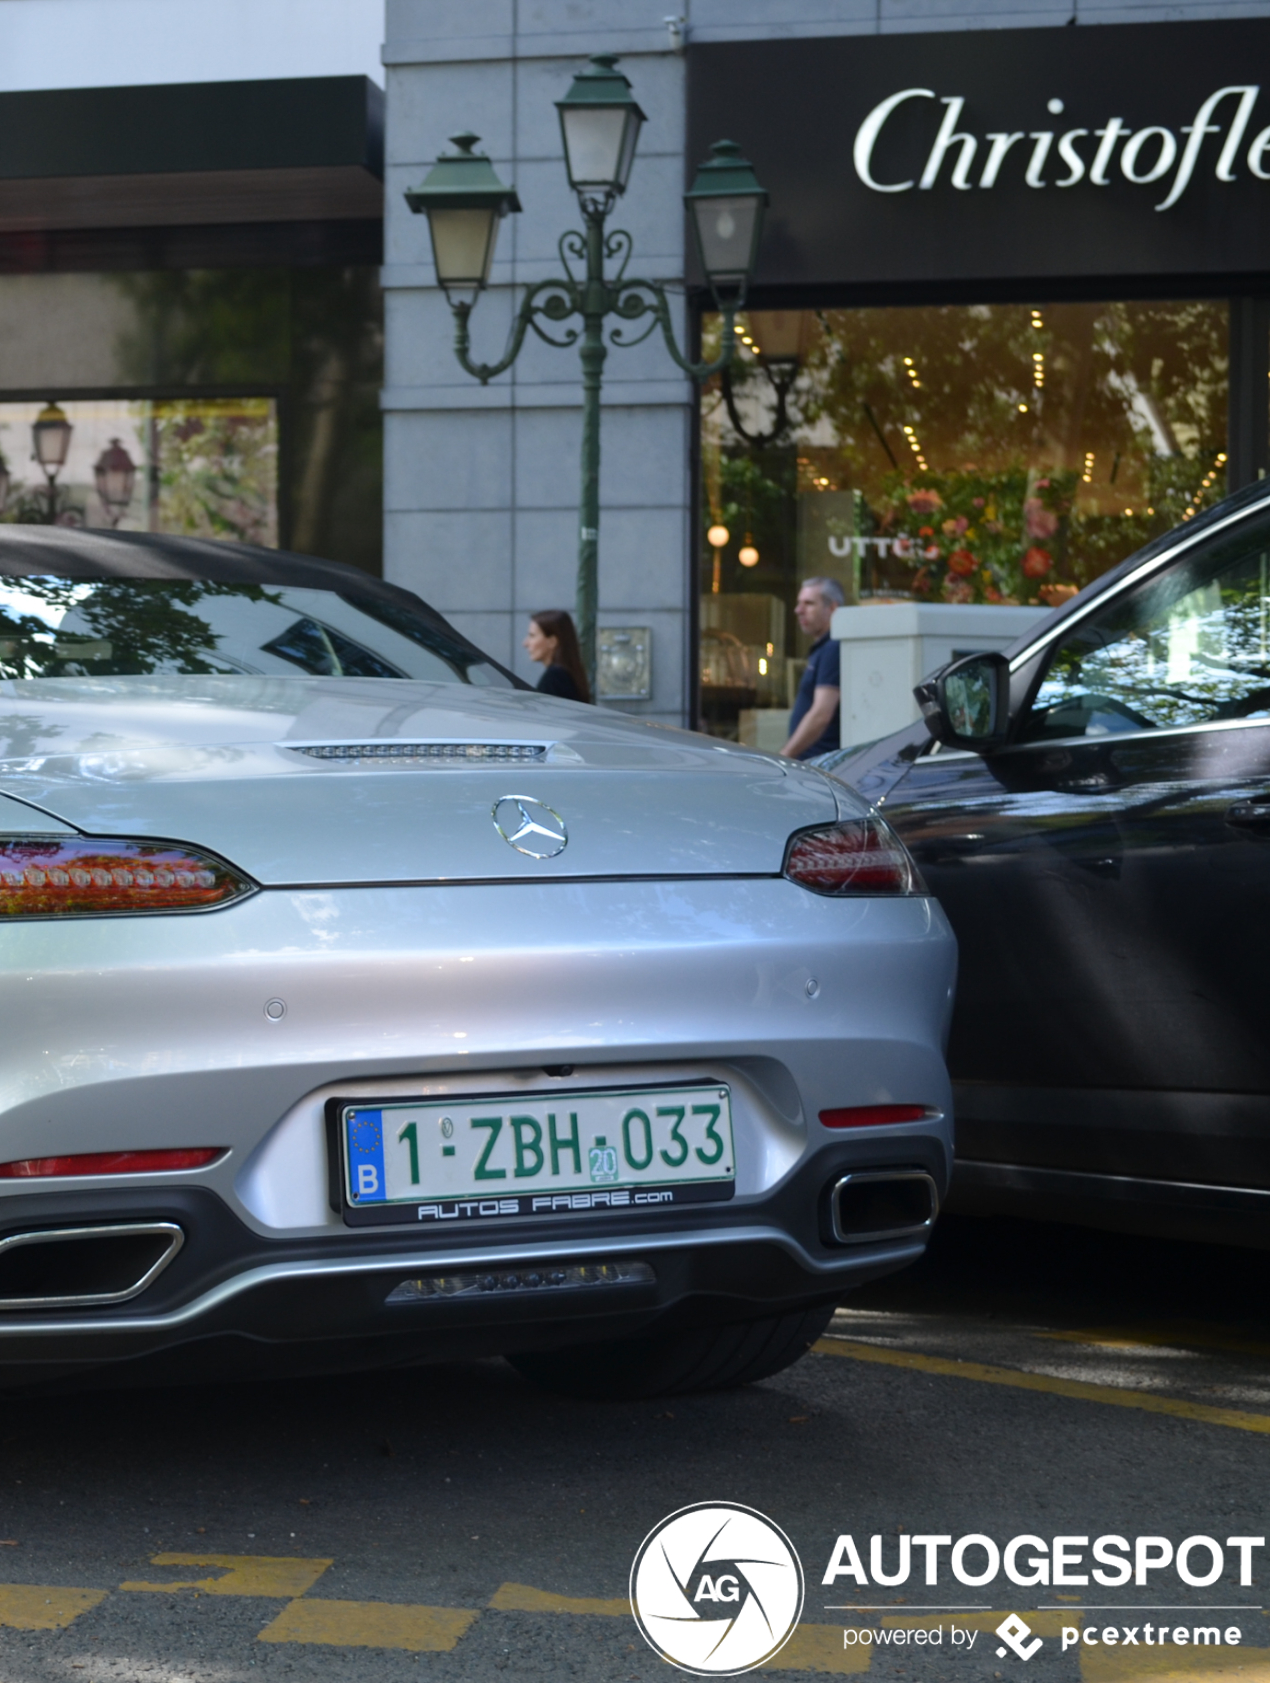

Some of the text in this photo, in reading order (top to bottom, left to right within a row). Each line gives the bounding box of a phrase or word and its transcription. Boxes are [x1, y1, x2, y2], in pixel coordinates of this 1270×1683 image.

[357, 1164, 379, 1194] B
[418, 1190, 673, 1220] AUTOS FABRE.com
